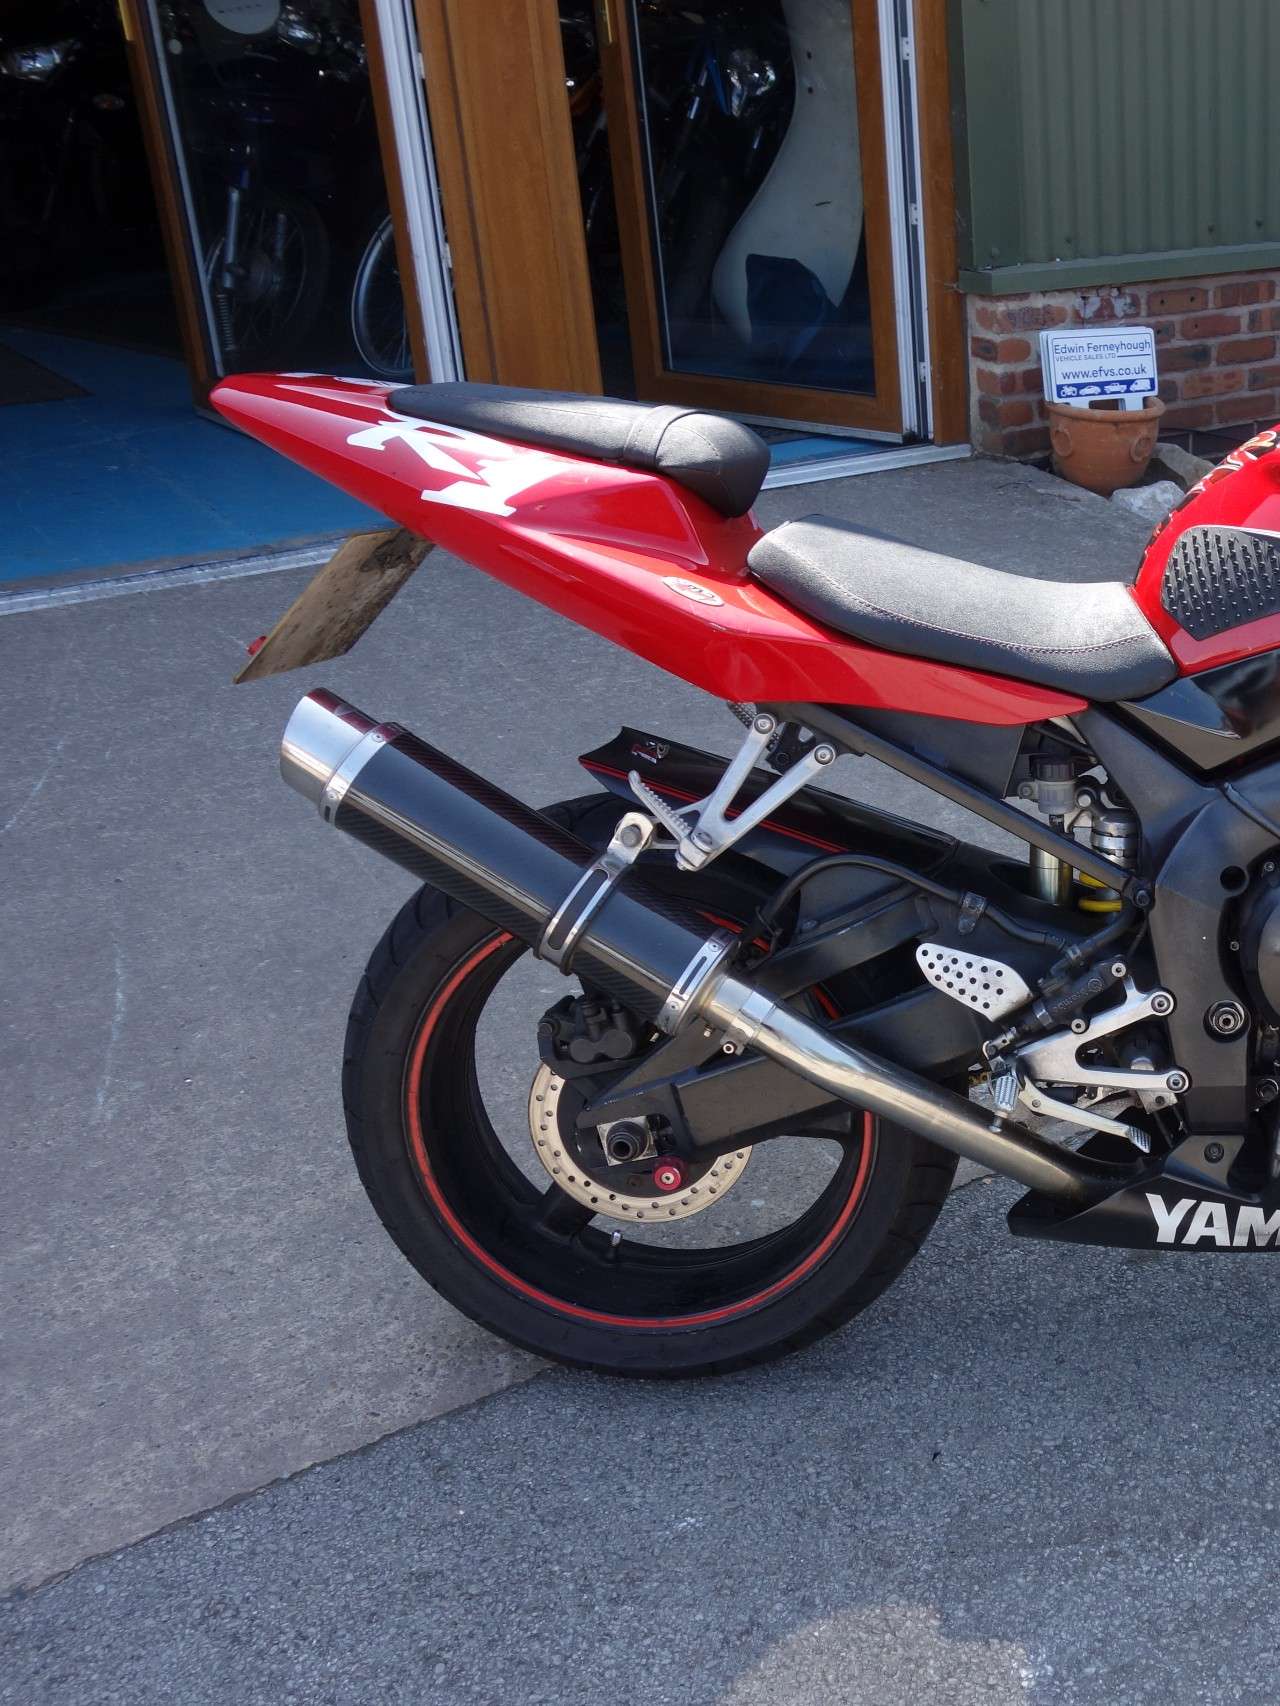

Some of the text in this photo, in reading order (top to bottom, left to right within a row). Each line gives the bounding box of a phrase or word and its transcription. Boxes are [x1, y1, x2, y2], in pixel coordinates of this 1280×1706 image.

[1054, 340, 1151, 355] Edwin Ferneyhough
[1055, 354, 1083, 362] VEHICLE
[1084, 353, 1104, 361] SALES
[1062, 364, 1147, 380] www.efvs.co.uk
